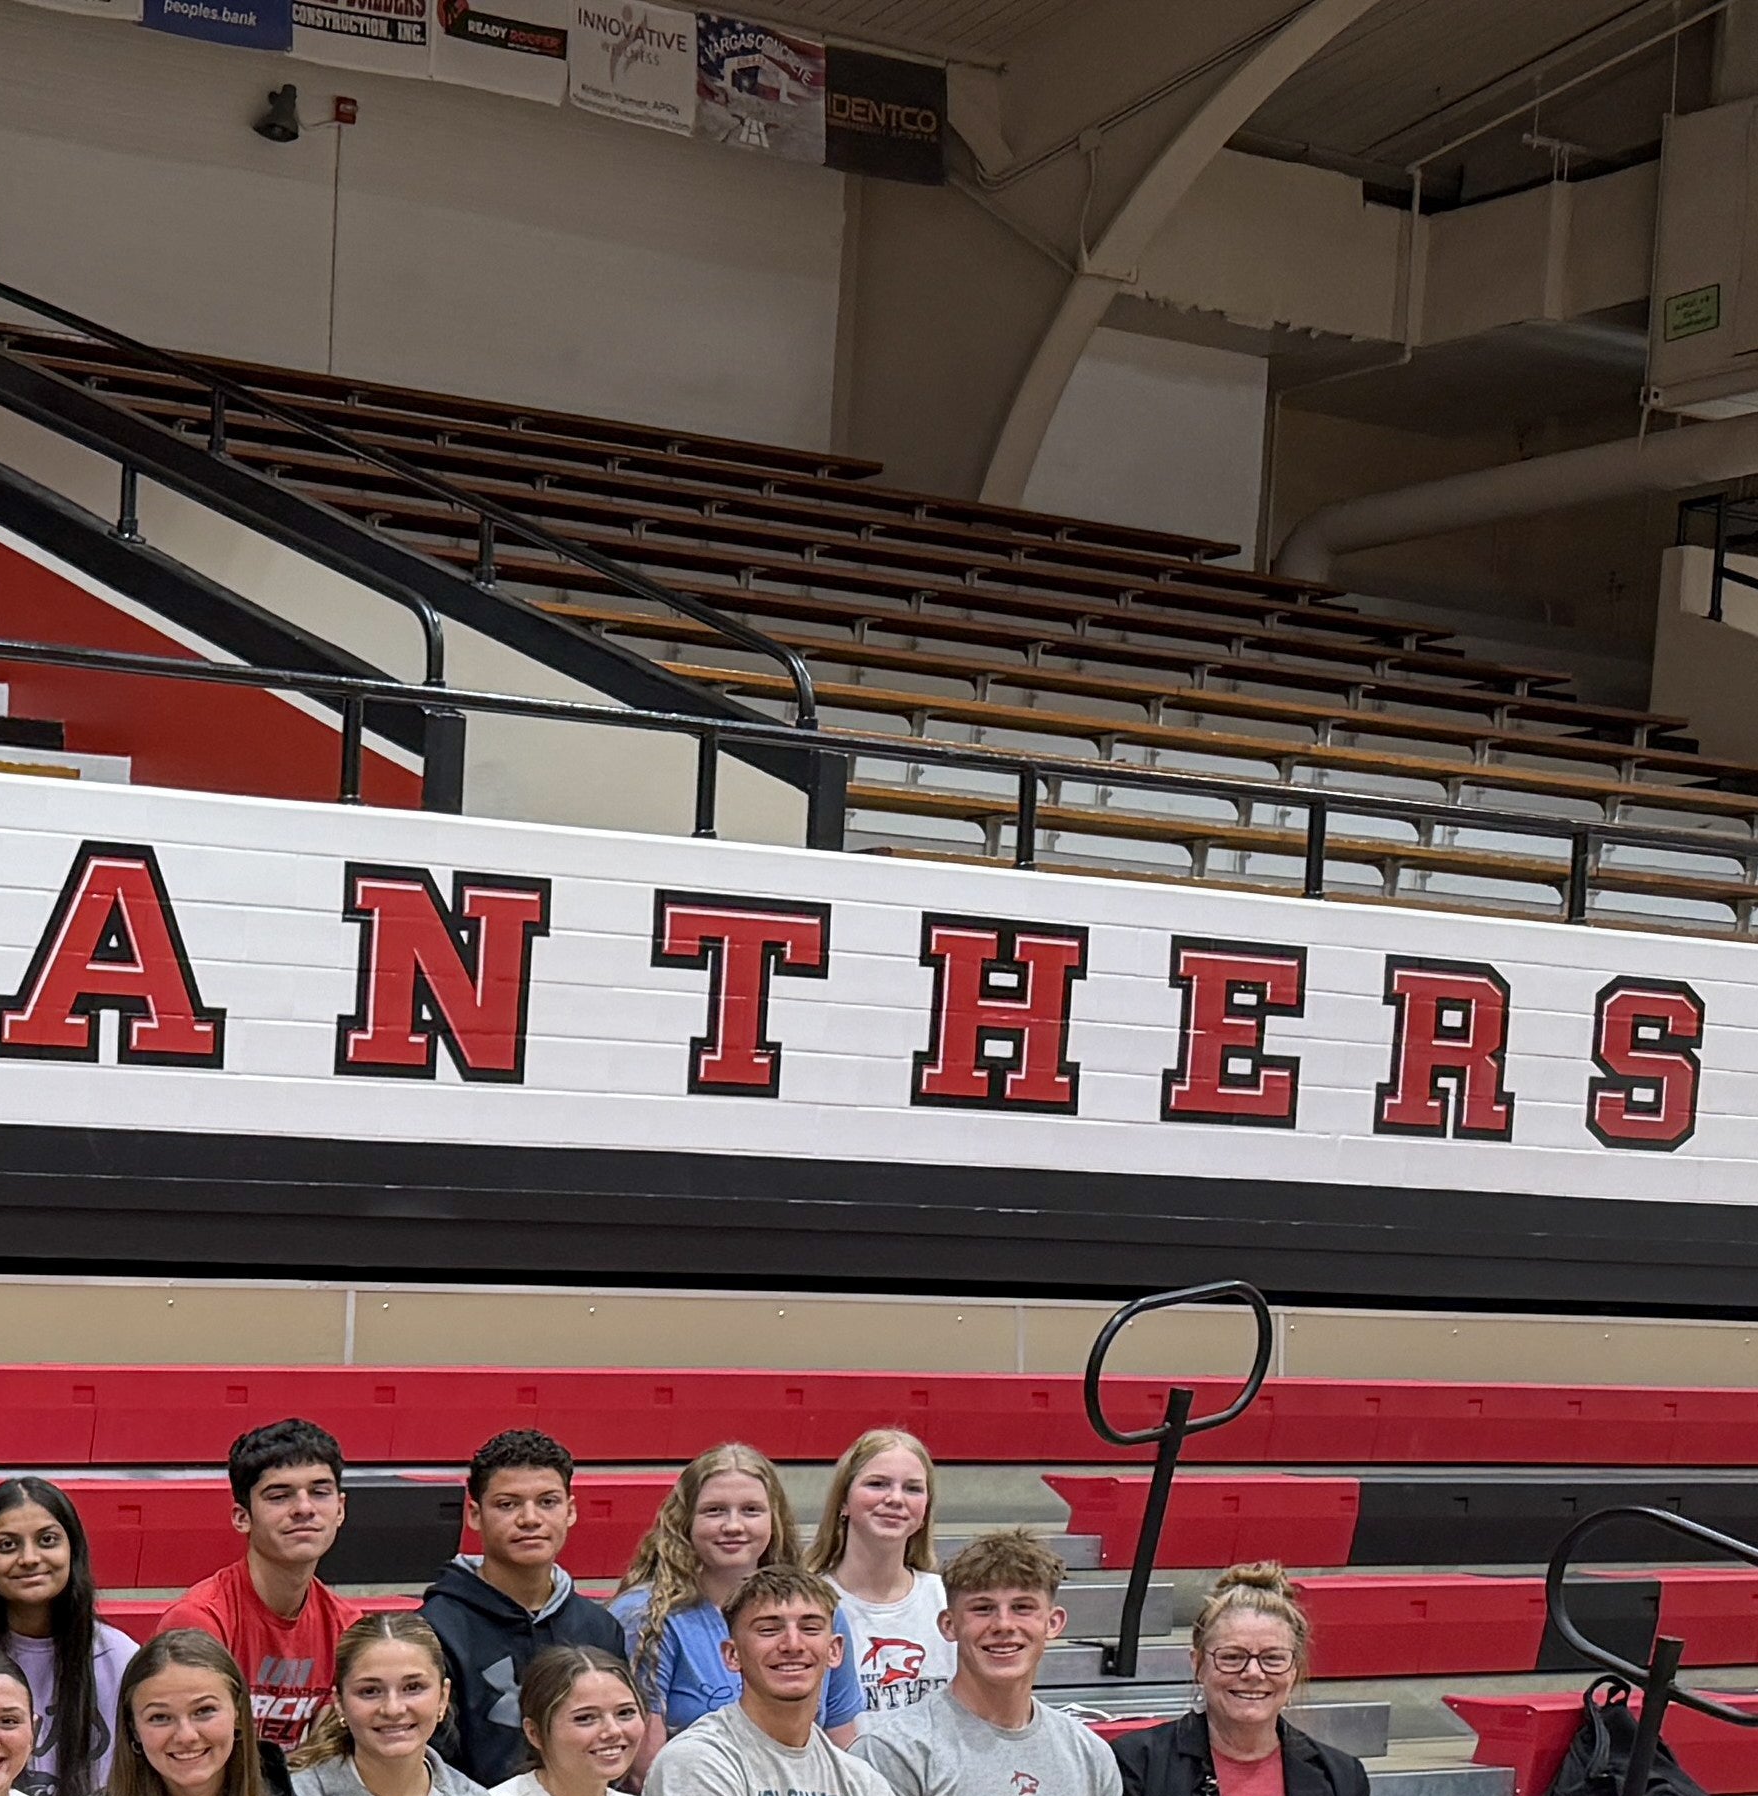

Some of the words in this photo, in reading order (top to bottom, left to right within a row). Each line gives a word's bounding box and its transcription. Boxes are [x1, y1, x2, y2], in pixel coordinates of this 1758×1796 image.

[397, 21, 426, 43] INC.
[468, 19, 508, 40] READY
[578, 7, 687, 53] INNOVATIVE
[704, 33, 756, 60] VARGAS
